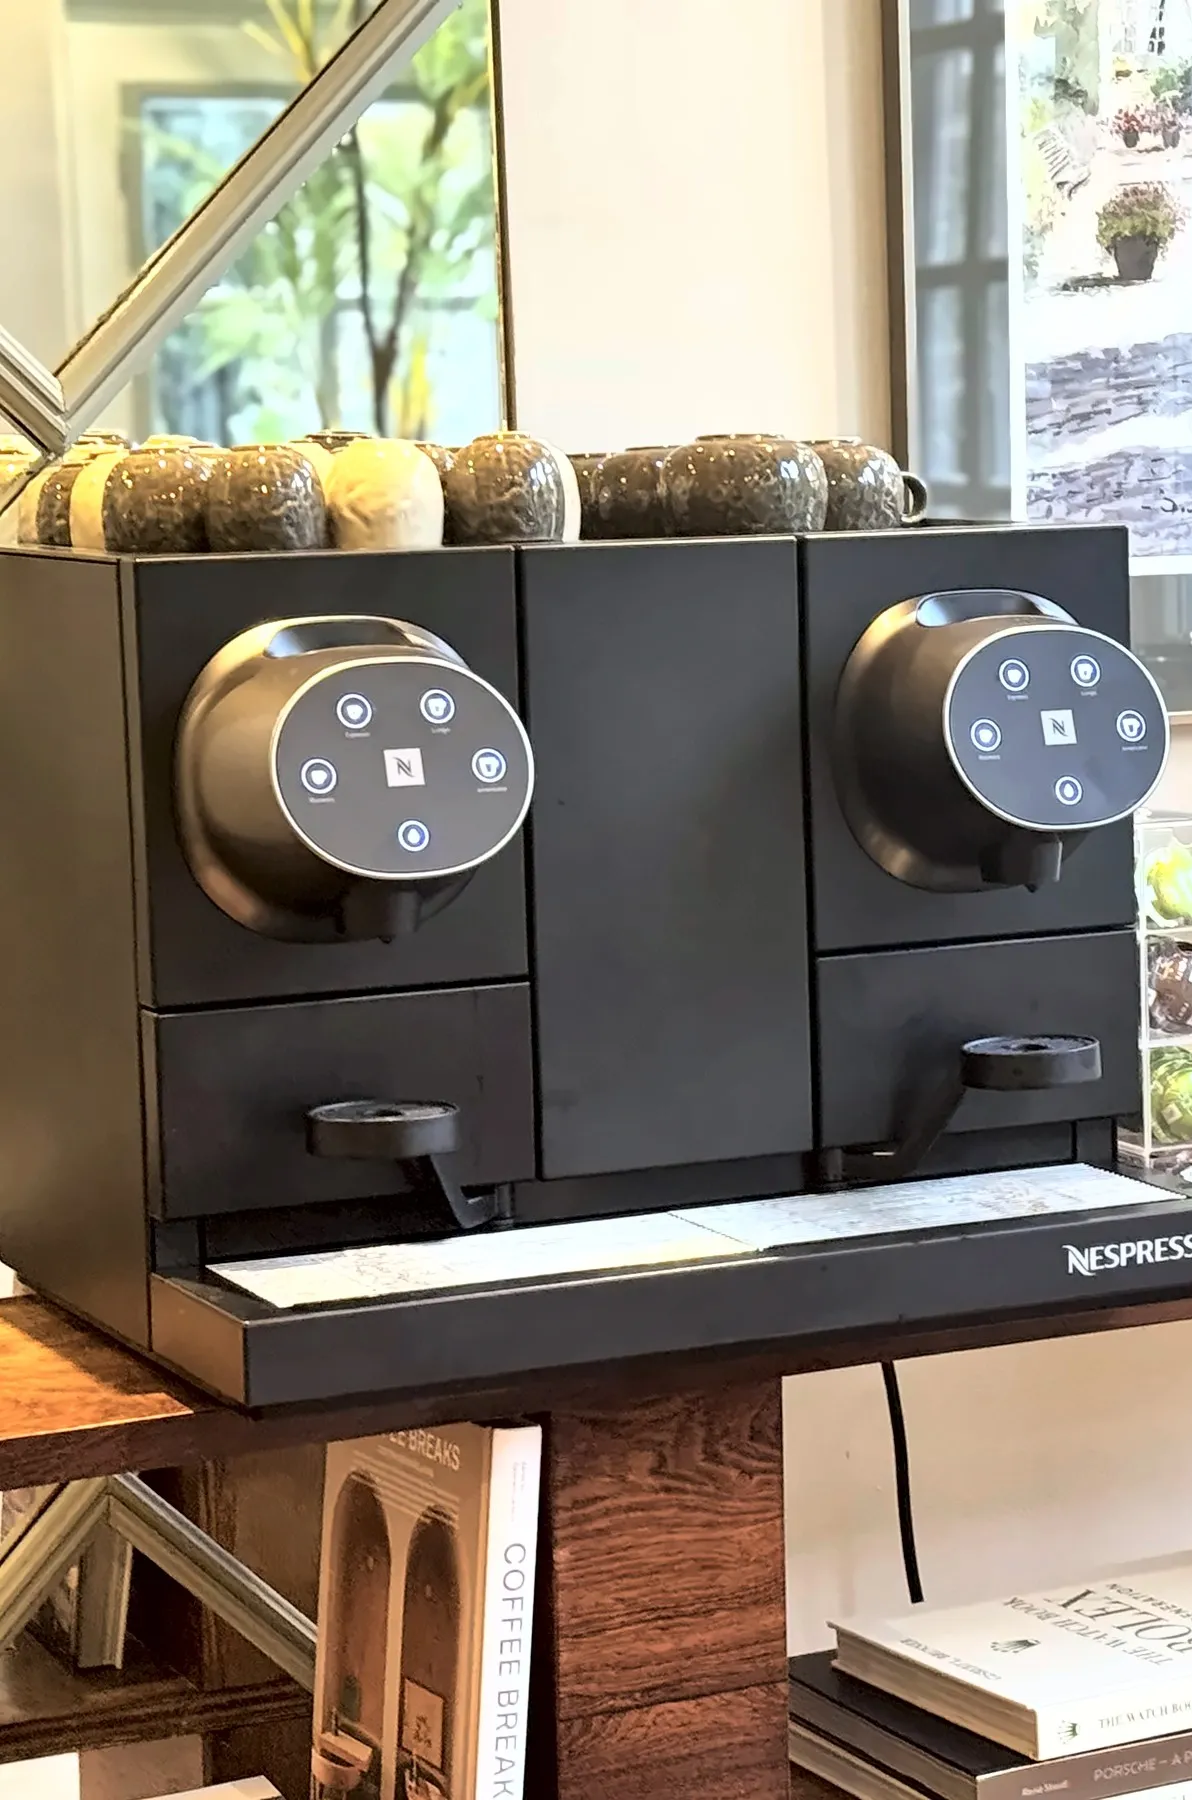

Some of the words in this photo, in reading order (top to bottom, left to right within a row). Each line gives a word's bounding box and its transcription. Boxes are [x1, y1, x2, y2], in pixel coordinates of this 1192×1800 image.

[408, 1430, 461, 1472] BREAKS
[498, 1543, 527, 1677] COFFEE
[1002, 1597, 1060, 1623] BOOK
[1052, 1617, 1127, 1649] WATCH
[1122, 1645, 1174, 1666] THE
[1099, 1714, 1123, 1729] THE
[1126, 1704, 1169, 1723] WATCH
[1093, 1757, 1156, 1782] PORSCHE
[1170, 1754, 1183, 1766] A
